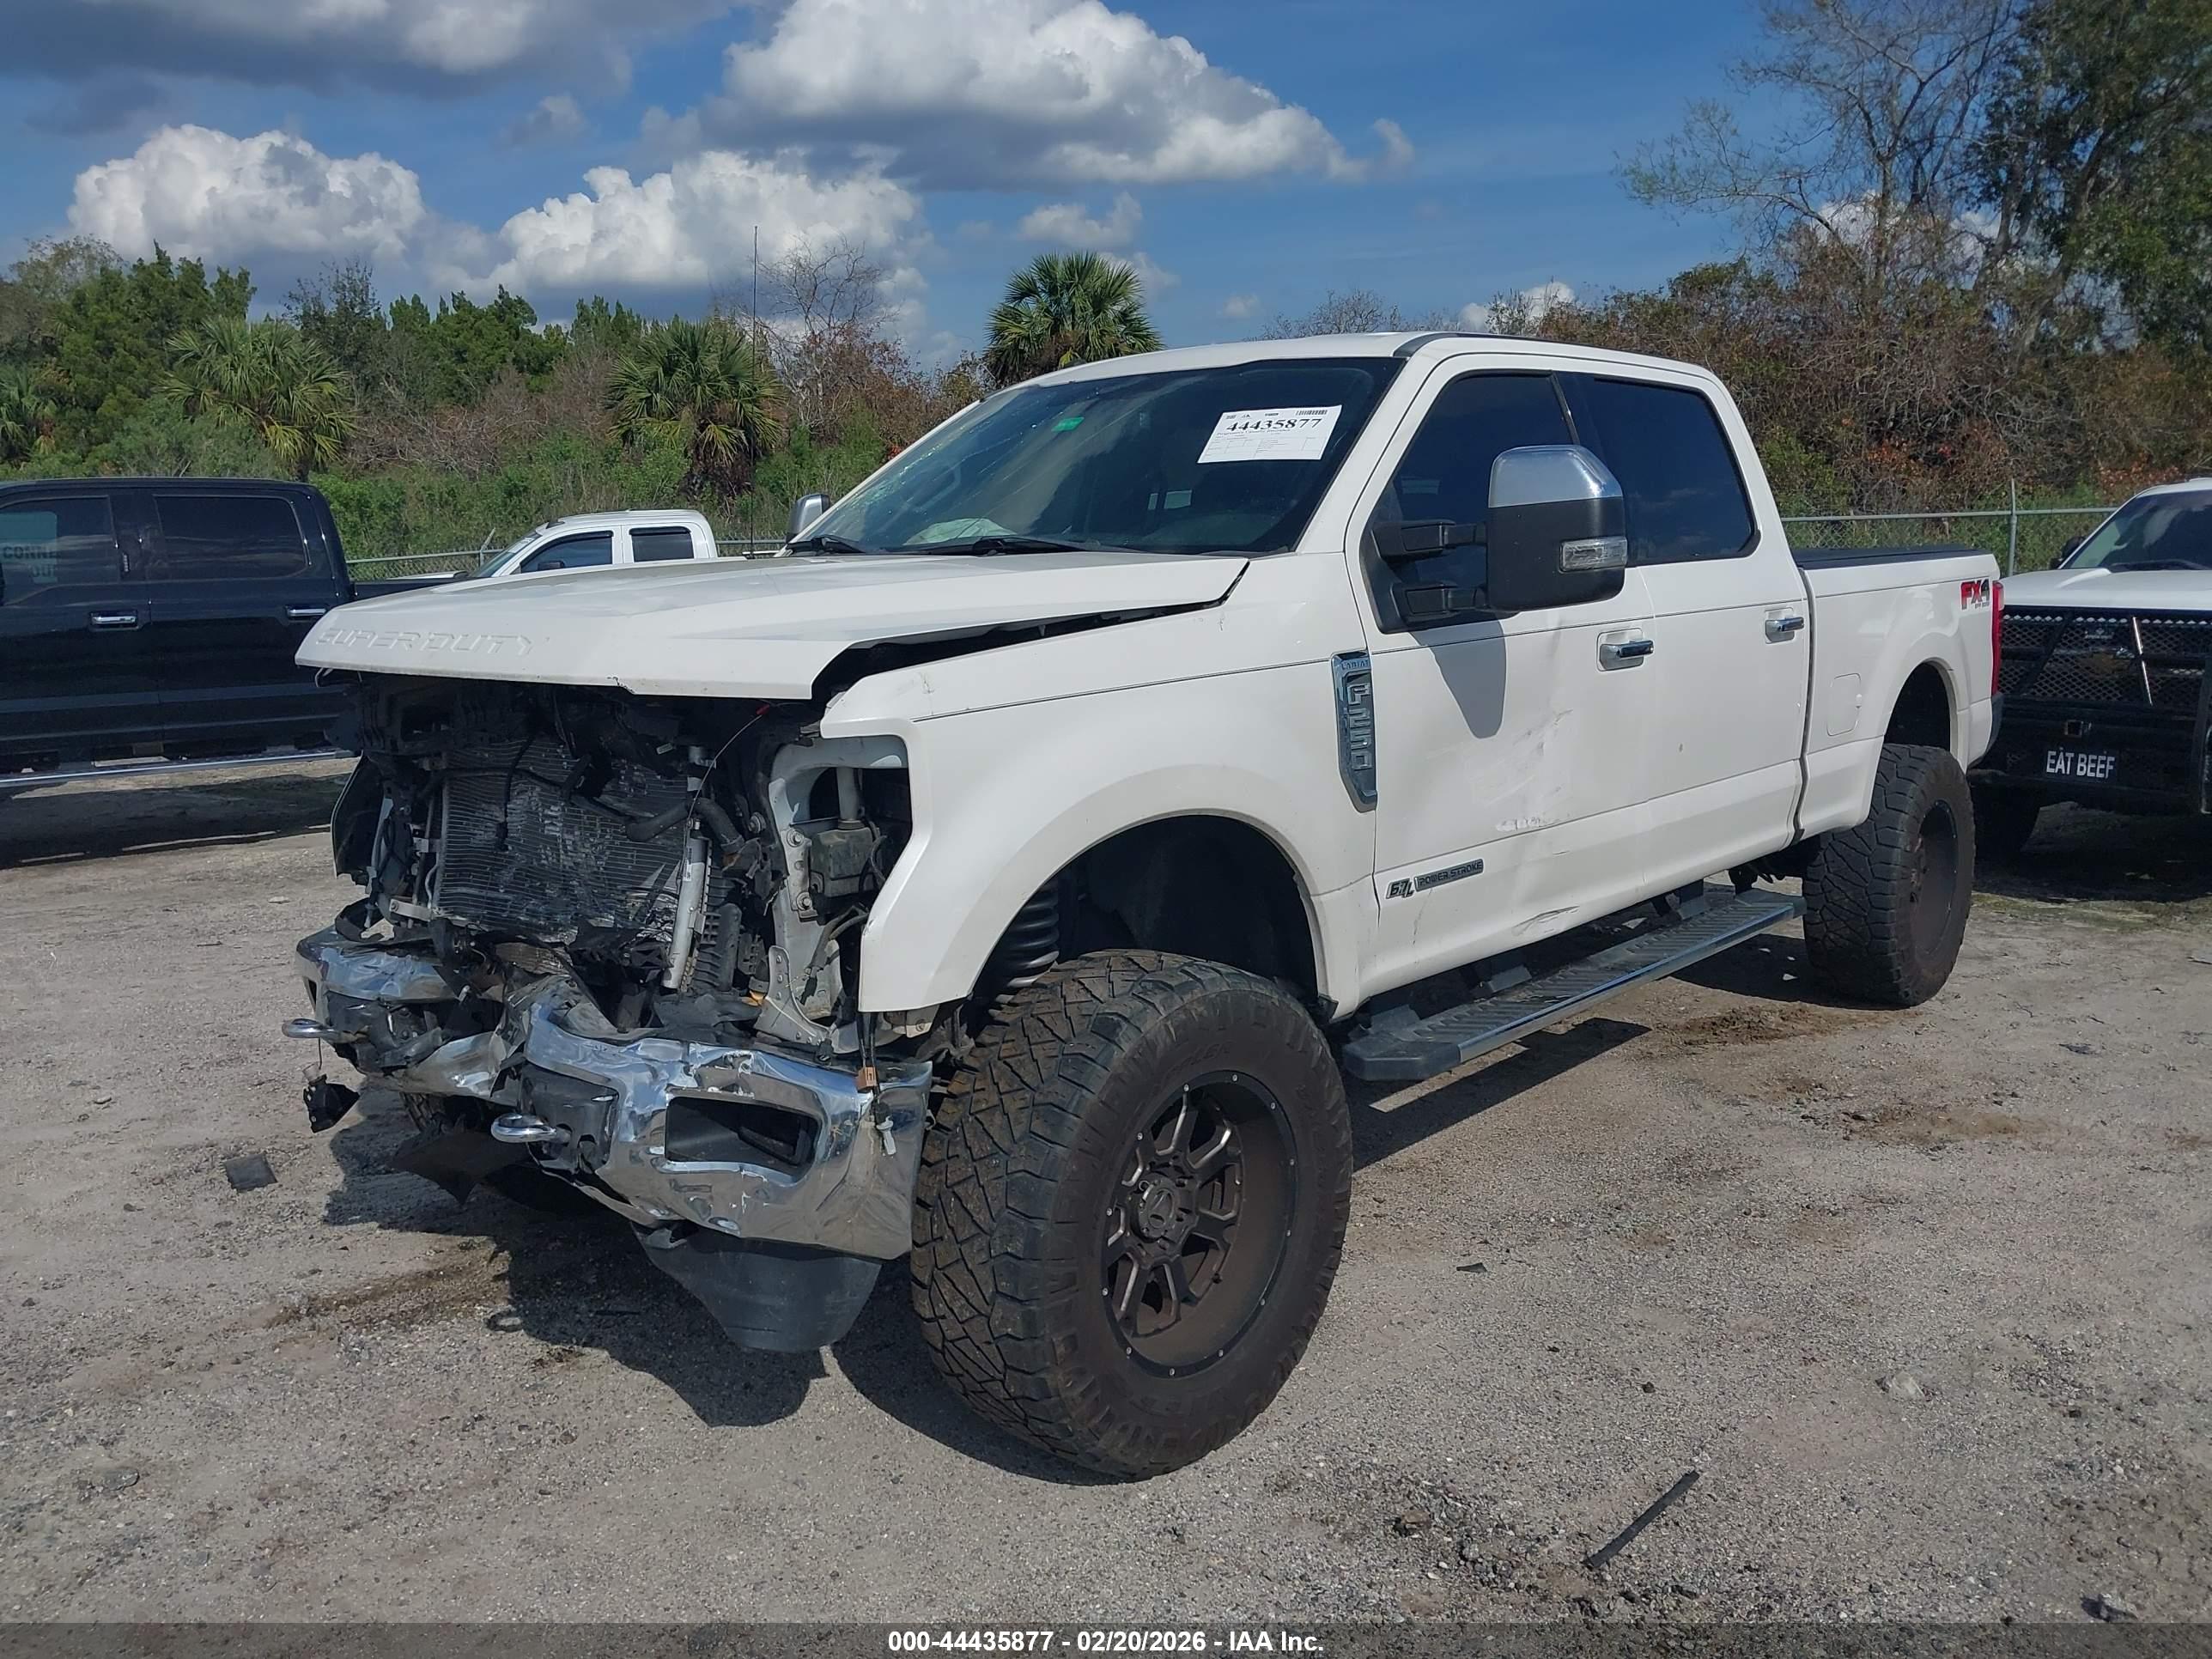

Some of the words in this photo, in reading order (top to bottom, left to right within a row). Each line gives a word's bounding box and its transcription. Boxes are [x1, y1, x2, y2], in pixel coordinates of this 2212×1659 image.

[1226, 418, 1322, 431] 44435877
[1961, 579, 1990, 610] FX4
[316, 628, 421, 651] SUPER
[420, 632, 532, 656] DUTY
[2046, 750, 2075, 775] EAT
[2076, 753, 2115, 779] BEEF
[1419, 872, 1449, 887] POWER
[1449, 860, 1482, 878] STROKE
